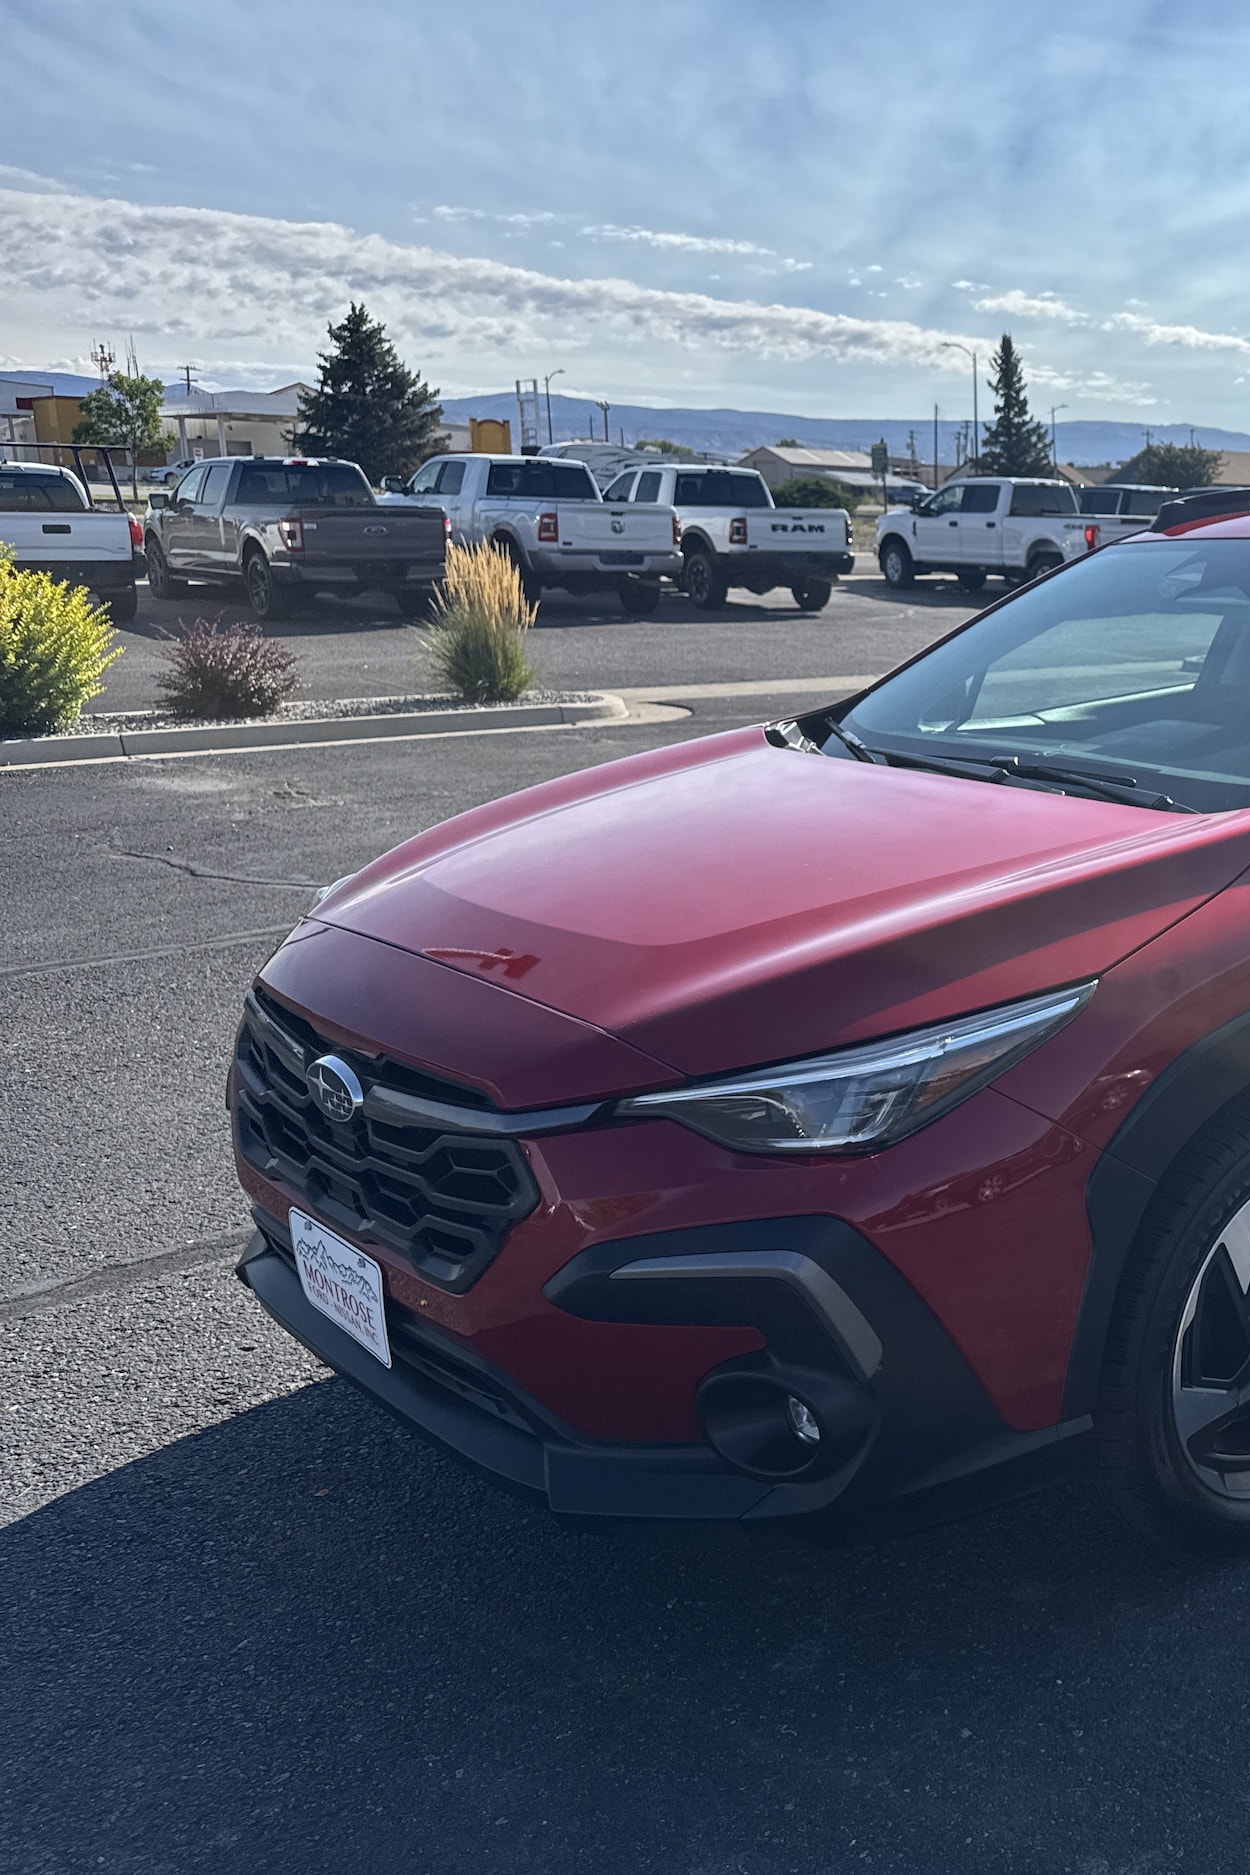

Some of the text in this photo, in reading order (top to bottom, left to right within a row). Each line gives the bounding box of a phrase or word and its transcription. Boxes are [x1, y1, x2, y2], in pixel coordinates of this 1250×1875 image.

[771, 524, 825, 533] RAM
[303, 1259, 376, 1331] MONTROSE
[308, 1281, 329, 1305] FORD
